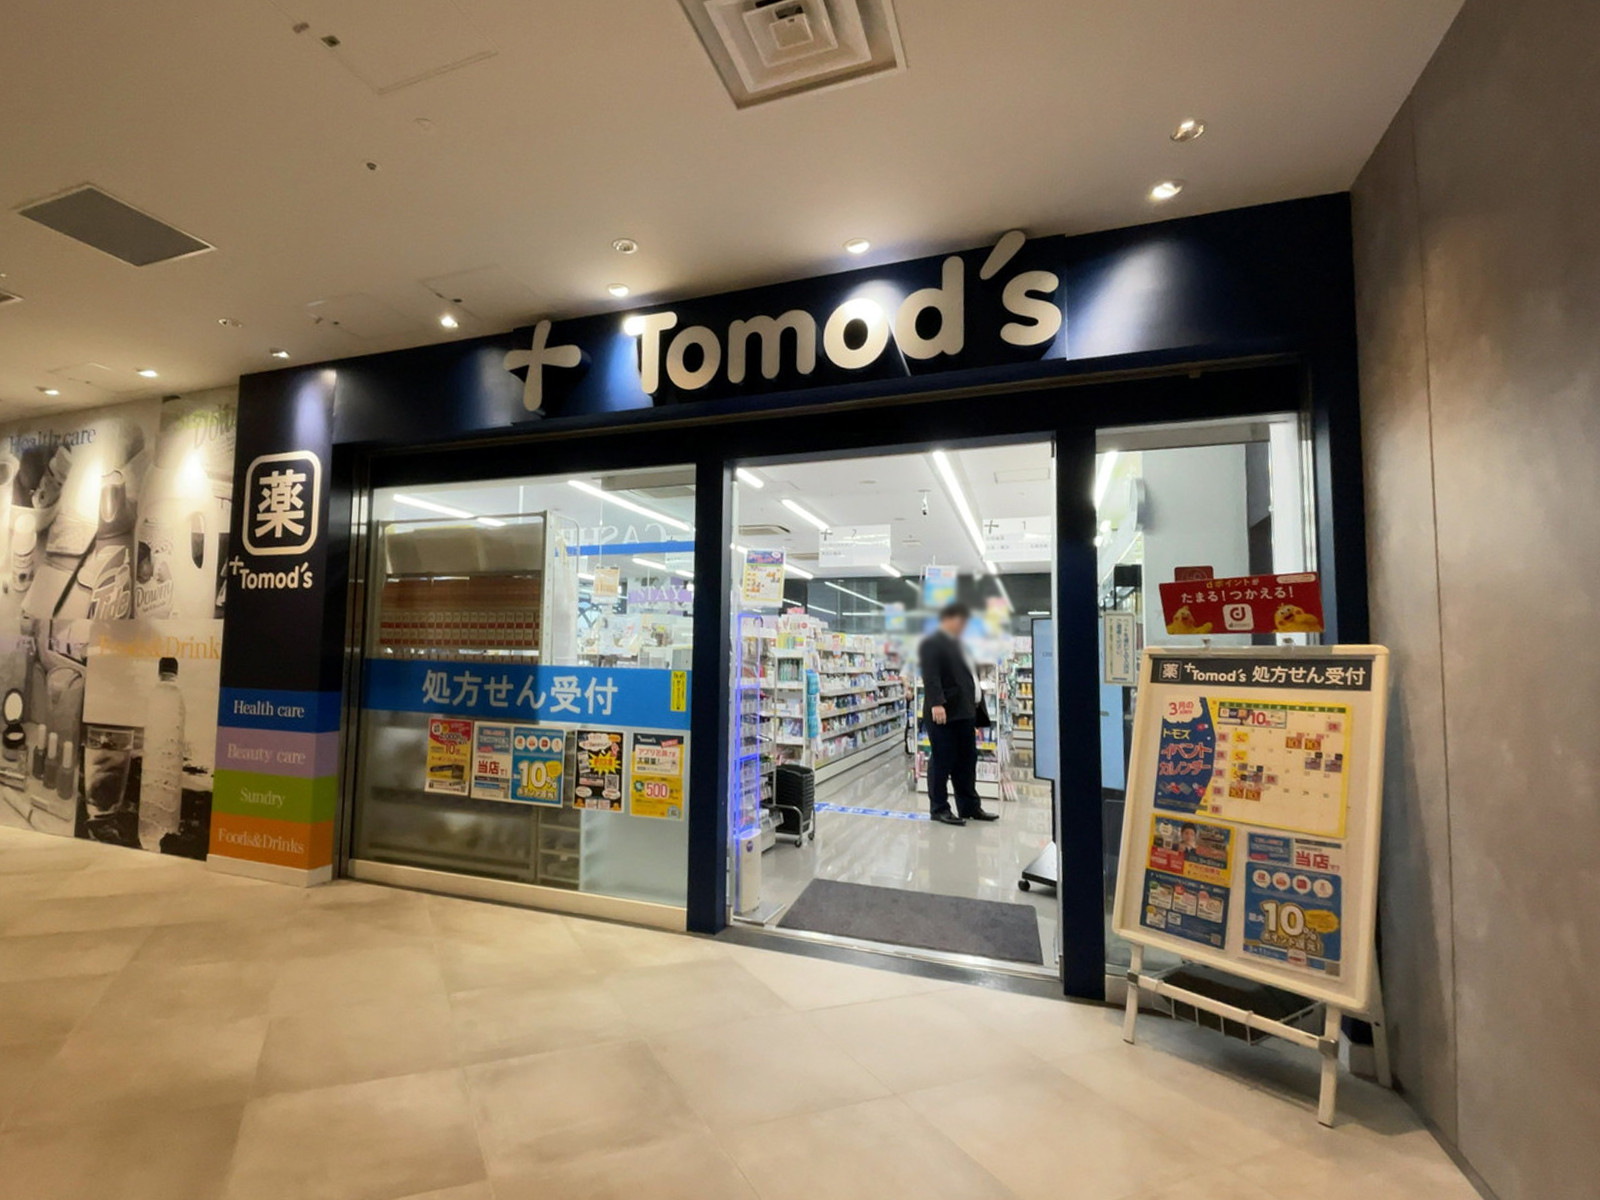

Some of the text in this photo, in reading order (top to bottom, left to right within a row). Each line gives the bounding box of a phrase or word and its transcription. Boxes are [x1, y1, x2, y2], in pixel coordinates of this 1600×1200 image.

[624, 230, 1062, 393] Tomod's
[63, 427, 97, 447] care
[255, 469, 306, 538] 薬
[239, 562, 313, 590] Tomod's
[1162, 663, 1366, 686] 薬 Tomod's 処方せん受付
[422, 669, 618, 716] 処方せん受付
[234, 700, 305, 718] Health care
[227, 743, 306, 764] Beauty care
[240, 788, 285, 808] Sundry
[218, 828, 305, 854] Foods&Drinks
